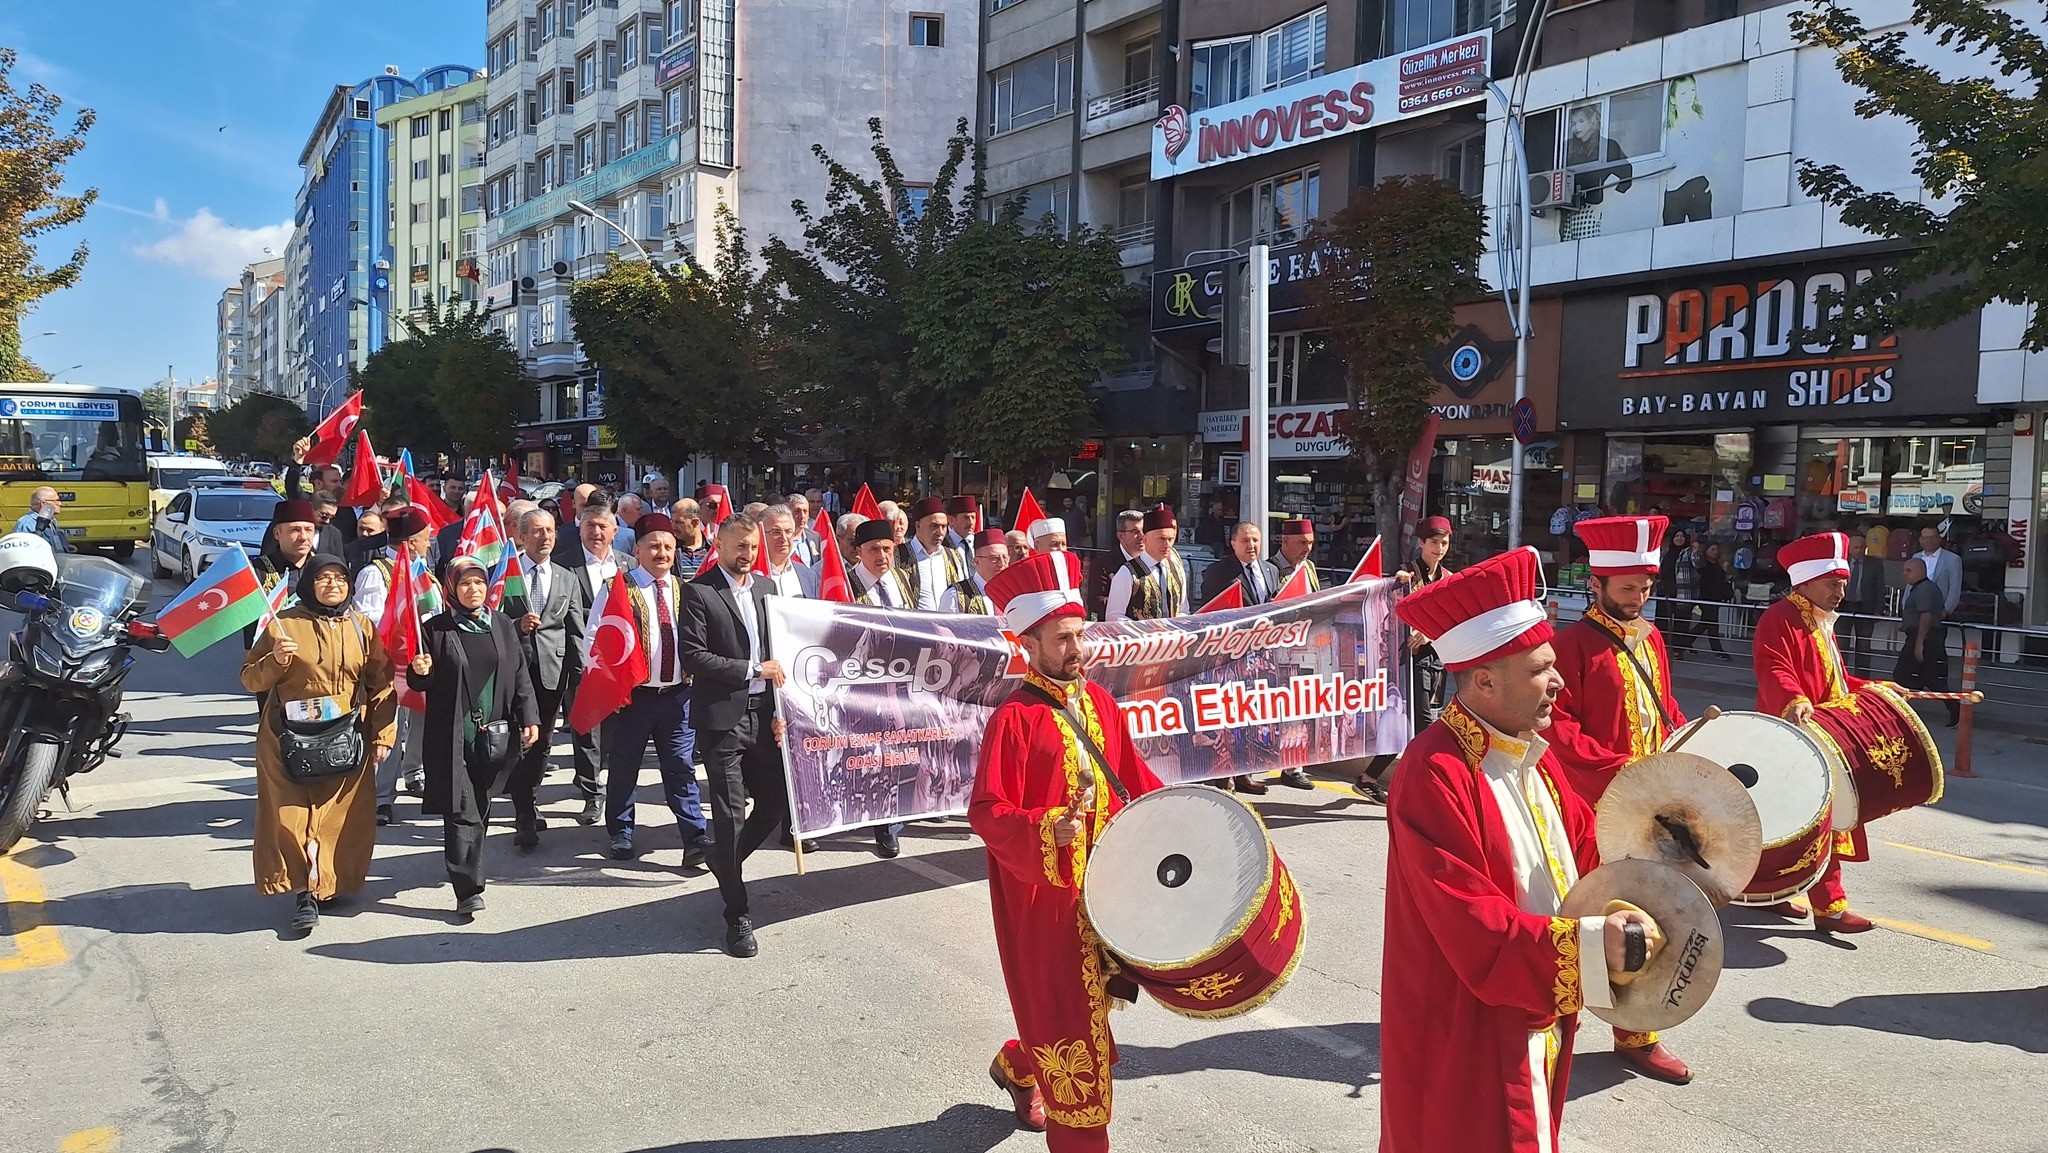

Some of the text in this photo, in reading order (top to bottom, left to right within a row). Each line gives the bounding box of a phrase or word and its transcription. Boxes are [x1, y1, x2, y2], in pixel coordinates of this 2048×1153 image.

[1402, 41, 1479, 75] Güzellik Merkezi
[1404, 67, 1476, 90] www.innovess.org
[1401, 94, 1428, 109] 0364
[1431, 87, 1453, 101] 666
[1553, 172, 1562, 201] VESTEL
[1622, 366, 1893, 415] BAY-BAYAN SHOES
[1211, 422, 1240, 432] MERKEZİ
[1295, 441, 1331, 452] DUYGU
[1226, 462, 1237, 479] E
[220, 525, 262, 534] TRAFİK
[1200, 618, 1309, 660] Haftası
[1196, 672, 1386, 727] Etkinlikleri
[803, 727, 958, 755] ÇORUM ESNAF SANATKARLAR
[846, 747, 921, 771] ODASI BİRLİĞİ
